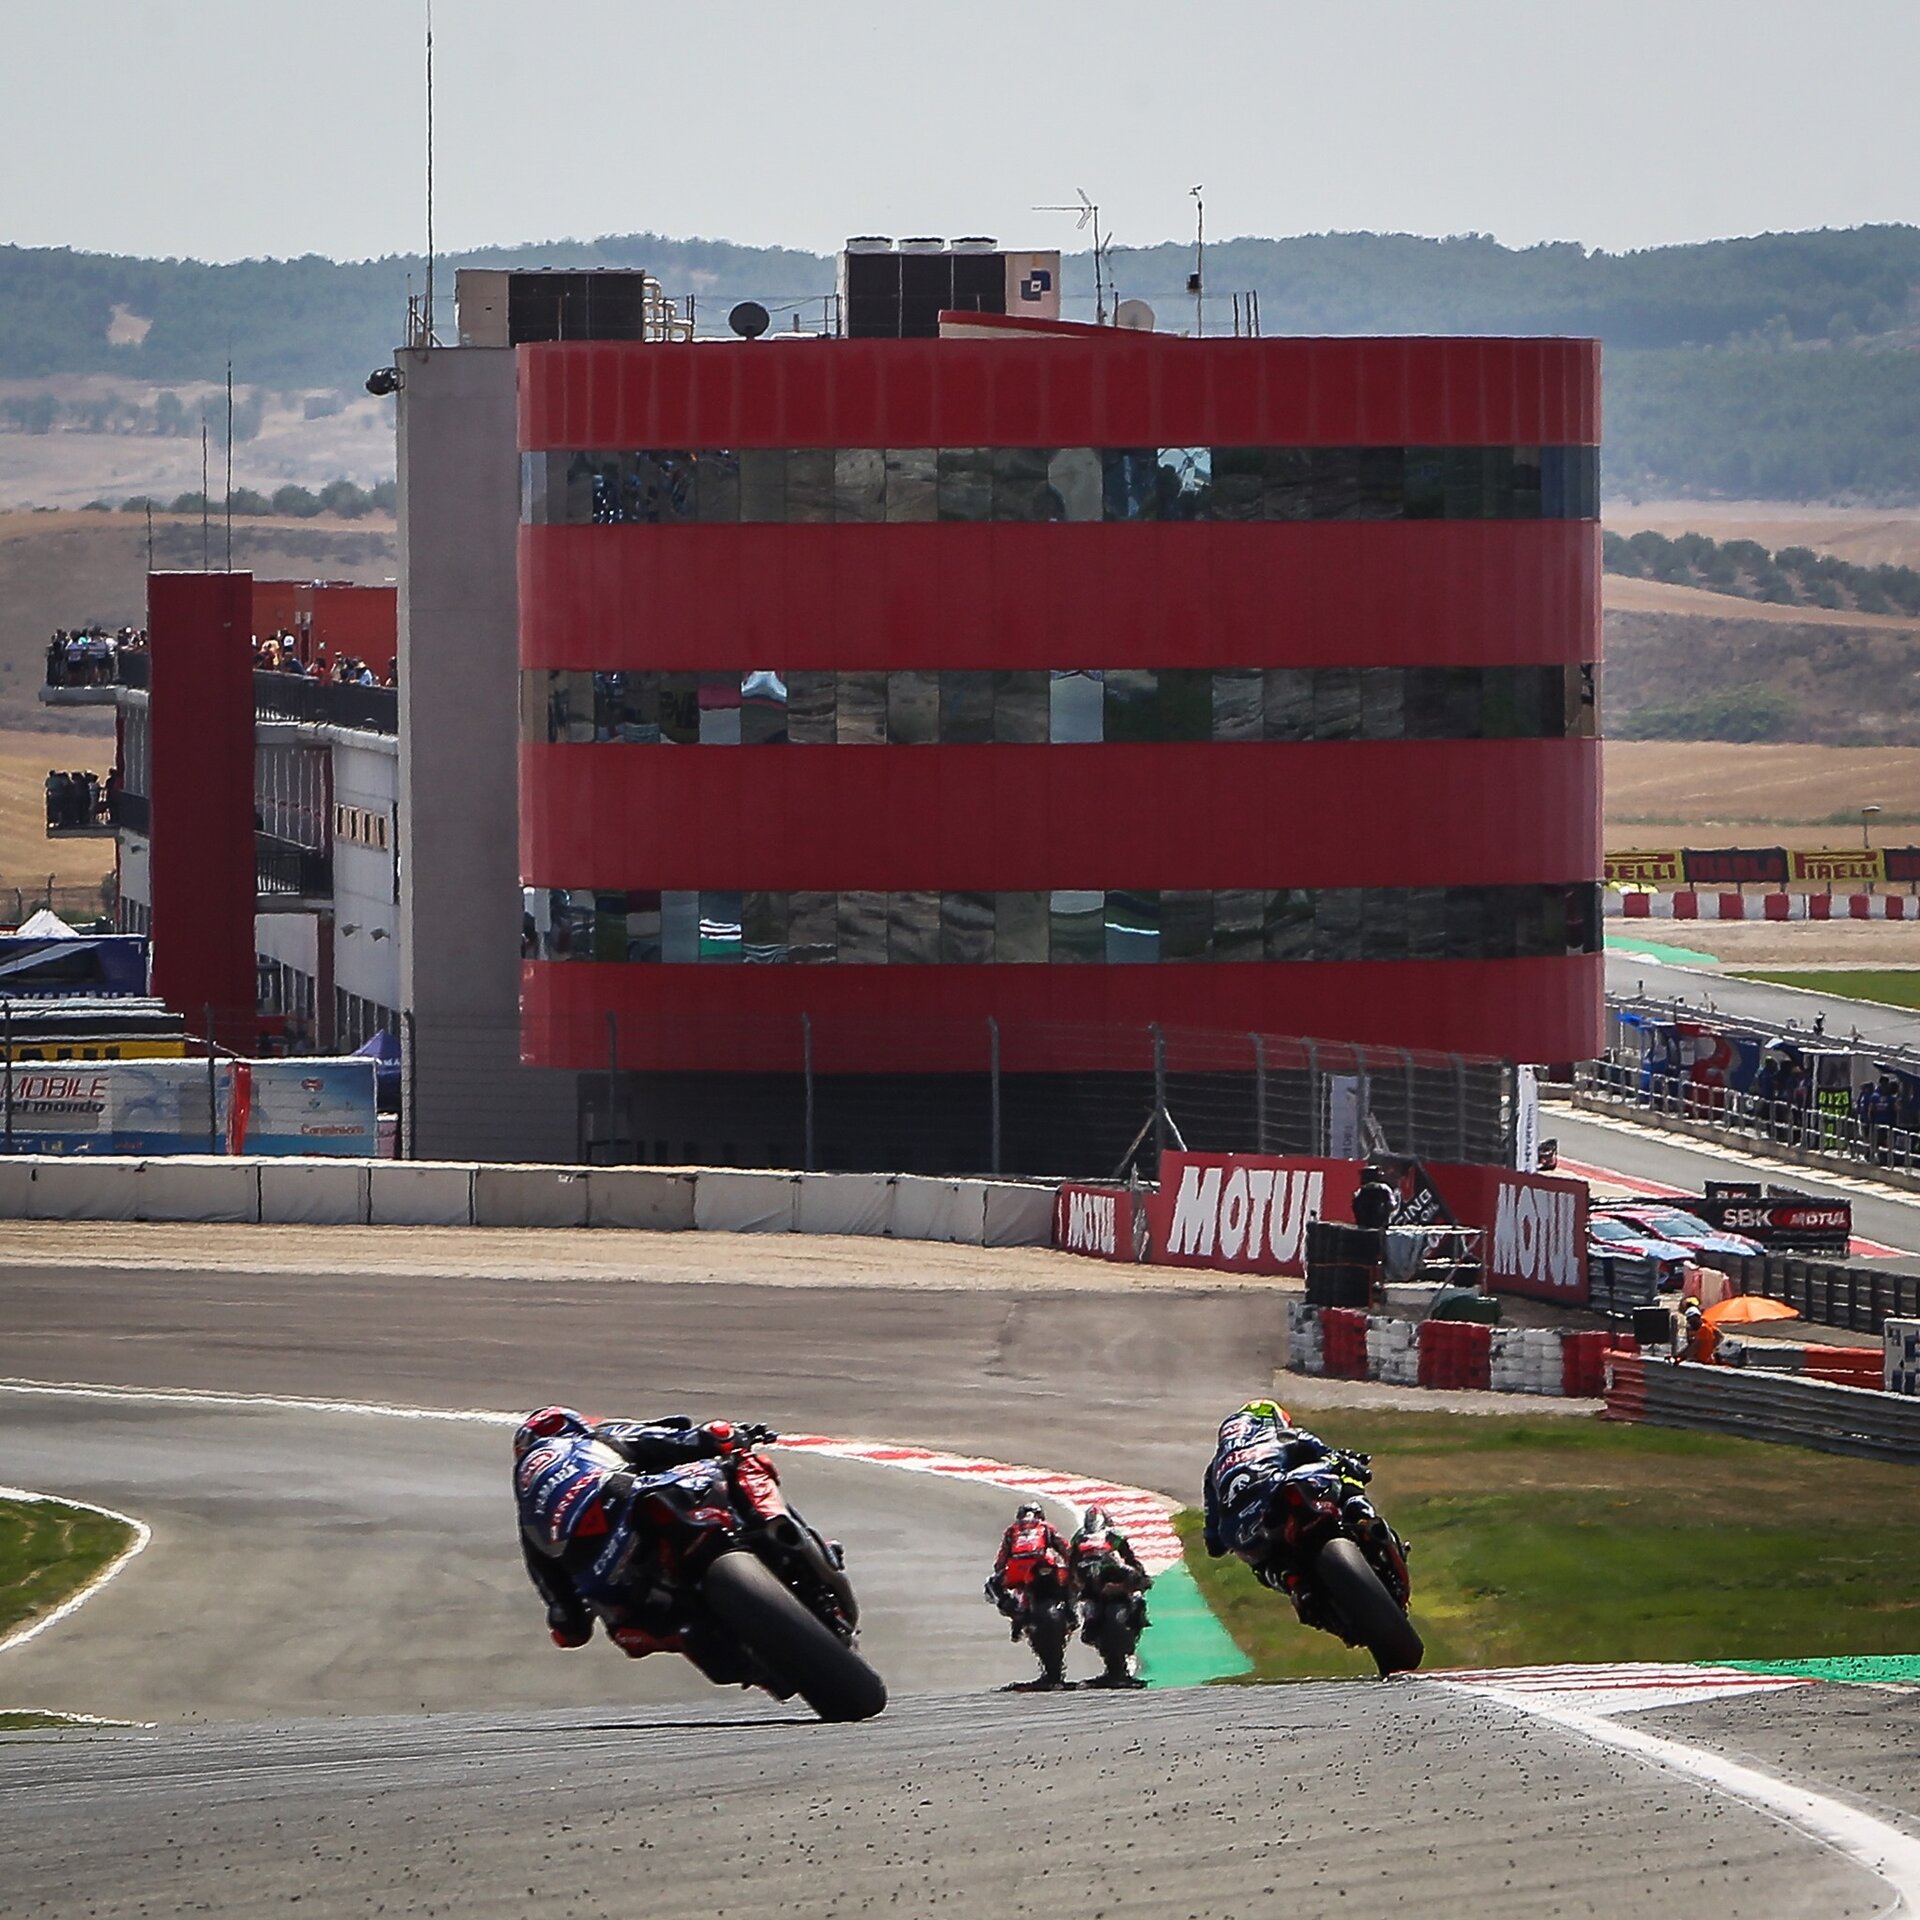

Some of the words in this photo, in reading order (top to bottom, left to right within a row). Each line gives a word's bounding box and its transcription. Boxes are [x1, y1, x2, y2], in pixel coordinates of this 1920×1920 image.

[1793, 851, 1879, 880] PIRELLI
[1067, 1191, 1115, 1254] MOTUL
[1493, 1183, 1579, 1286] MOTUL
[1722, 1208, 1773, 1228] SBK
[1790, 1211, 1846, 1227] MOTUL
